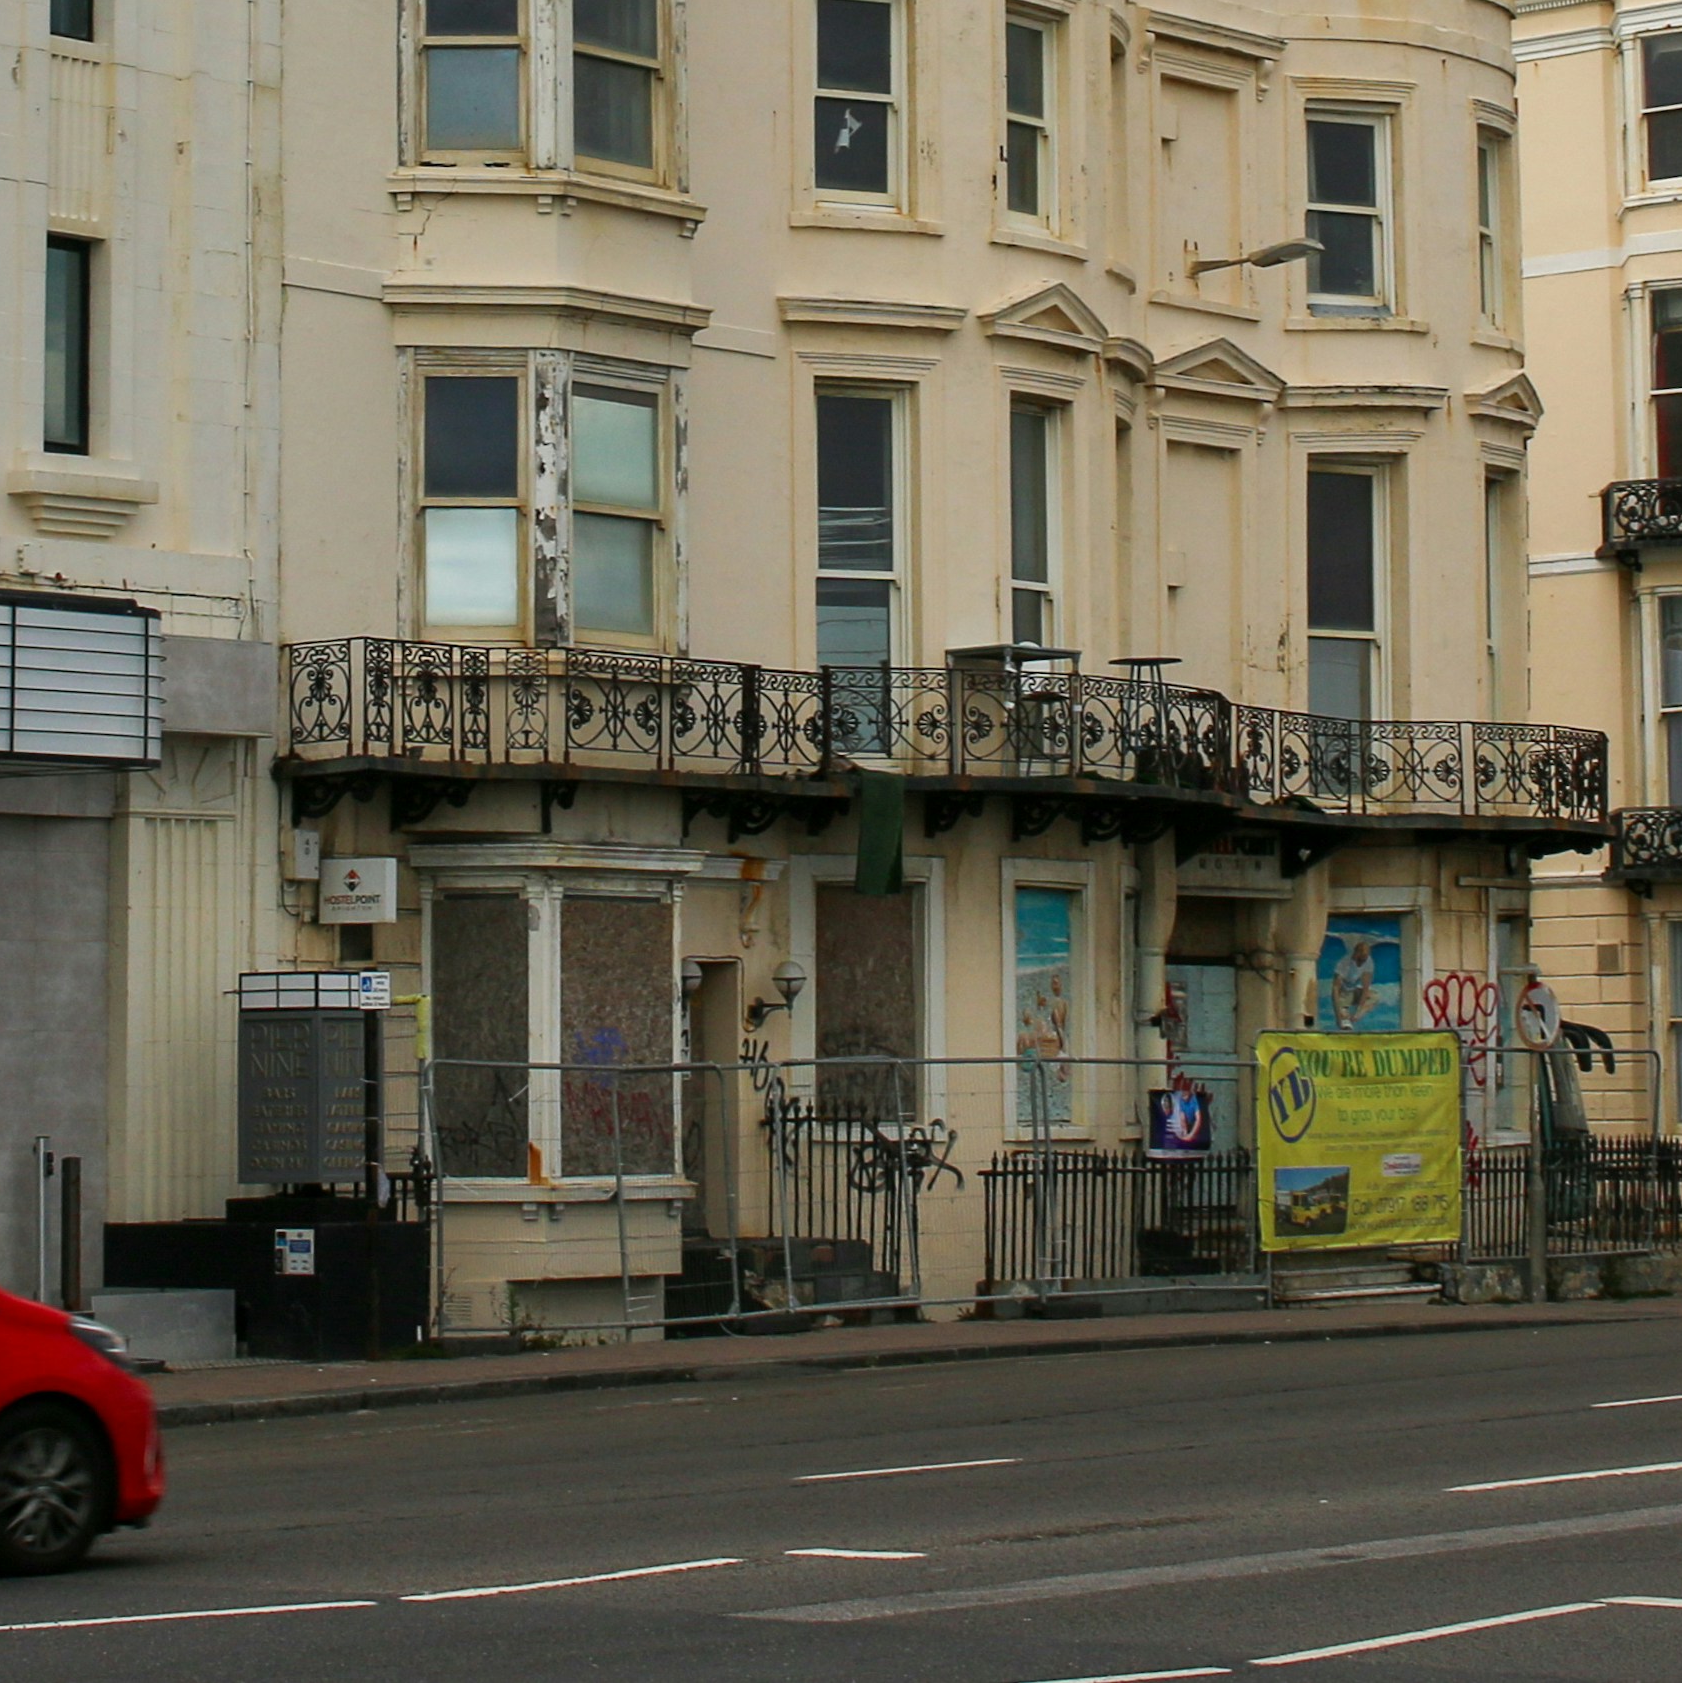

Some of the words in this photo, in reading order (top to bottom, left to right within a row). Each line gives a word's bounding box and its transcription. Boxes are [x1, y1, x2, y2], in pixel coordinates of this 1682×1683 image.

[1293, 1049, 1366, 1078] YOU'RE
[1372, 1048, 1451, 1077] DUMPED
[1355, 1086, 1381, 1099] more
[1383, 1084, 1405, 1098] than
[1352, 1198, 1371, 1216] Call
